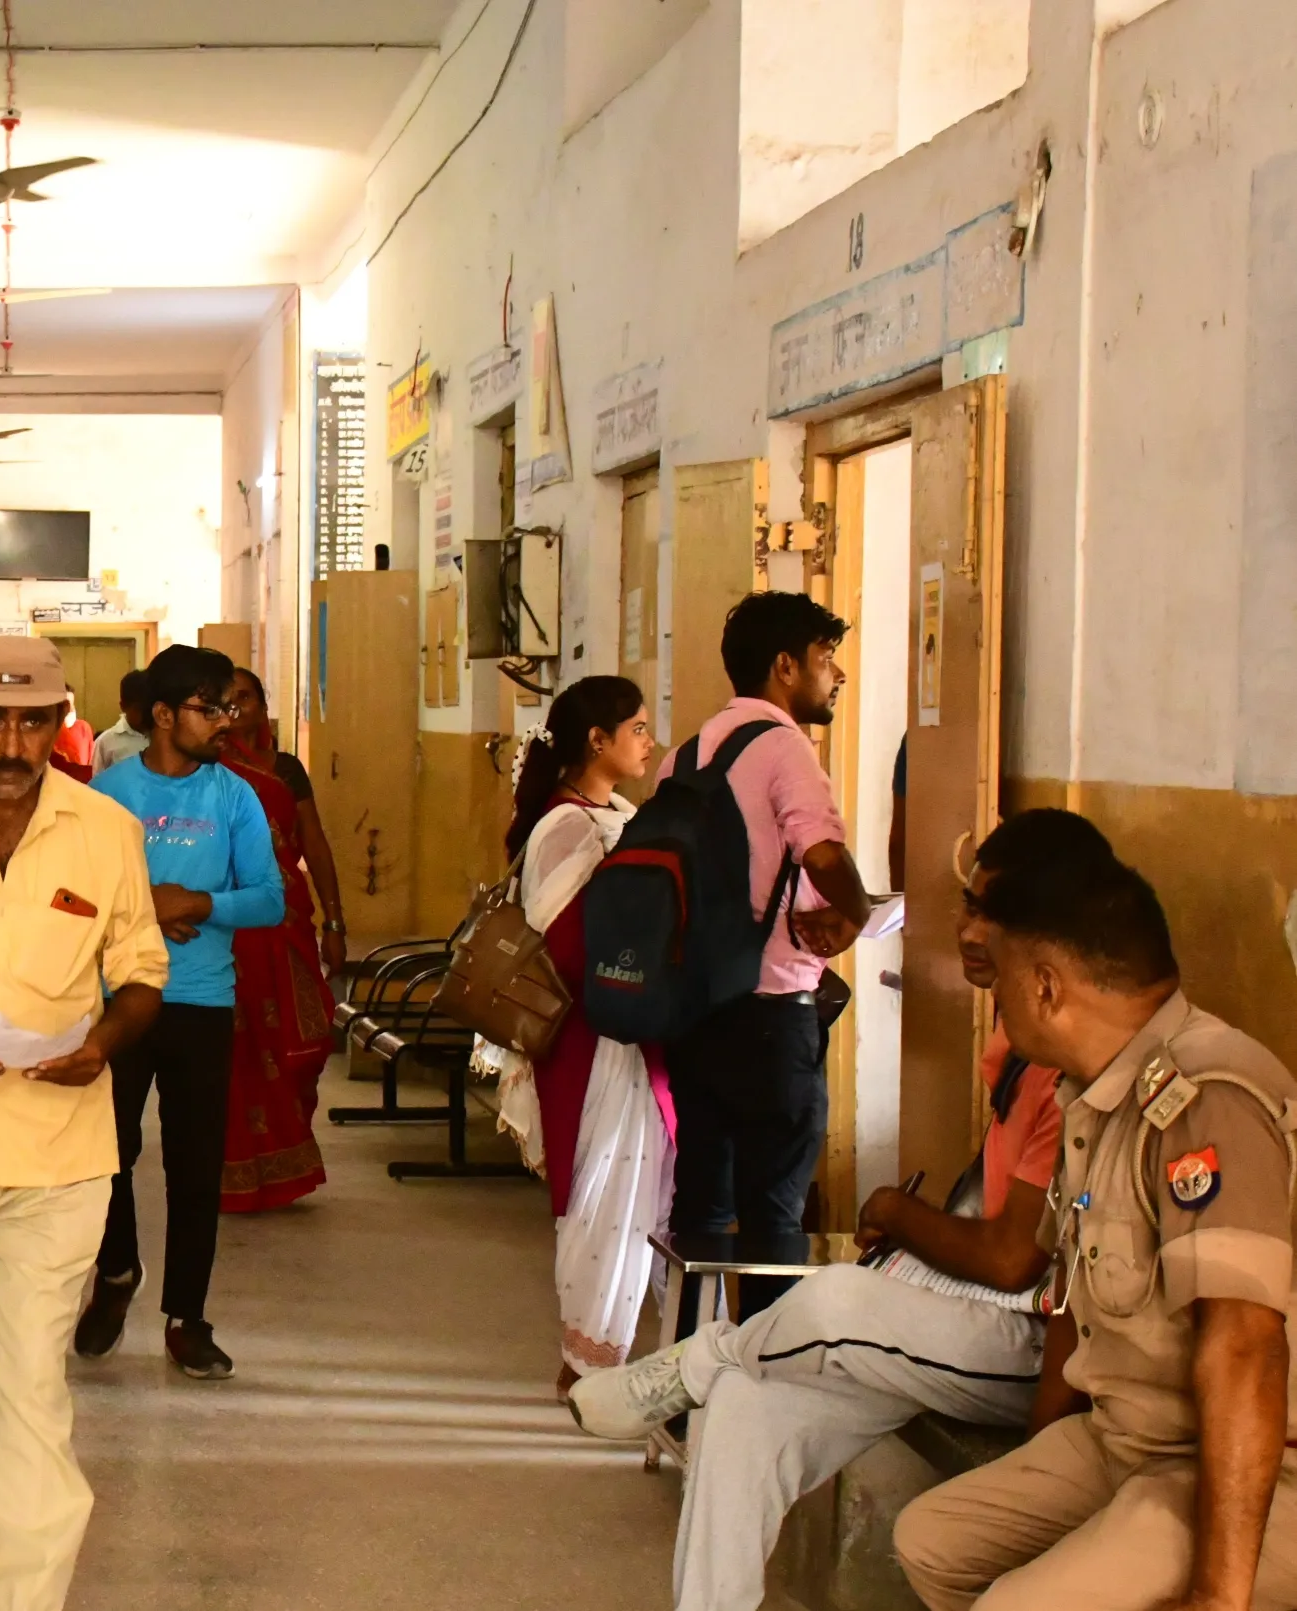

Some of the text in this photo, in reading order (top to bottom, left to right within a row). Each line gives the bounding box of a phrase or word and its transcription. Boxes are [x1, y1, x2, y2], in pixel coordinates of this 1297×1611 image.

[845, 212, 864, 273] 18
[405, 449, 427, 473] 15
[595, 961, 645, 984] Aakash
